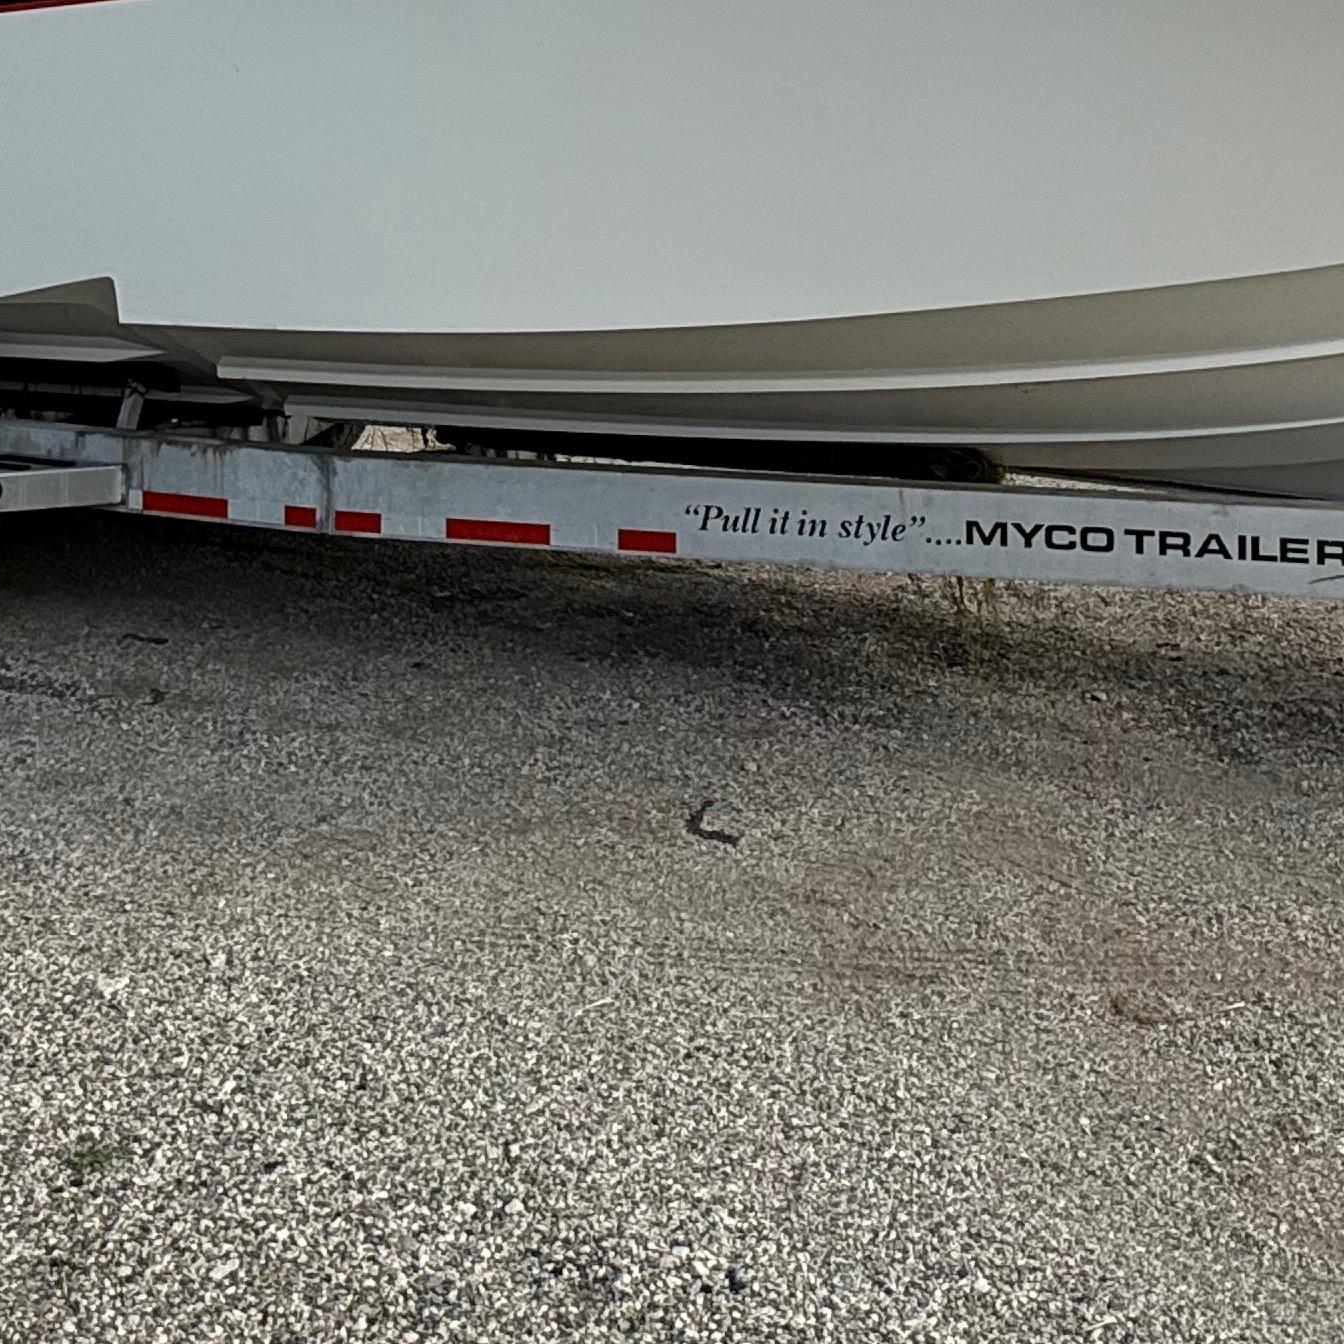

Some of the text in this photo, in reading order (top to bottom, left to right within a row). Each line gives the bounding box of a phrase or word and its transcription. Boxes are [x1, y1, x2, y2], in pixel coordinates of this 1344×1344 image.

[768, 508, 790, 536] it
[797, 509, 827, 538] in
[964, 519, 1115, 553] MYCO
